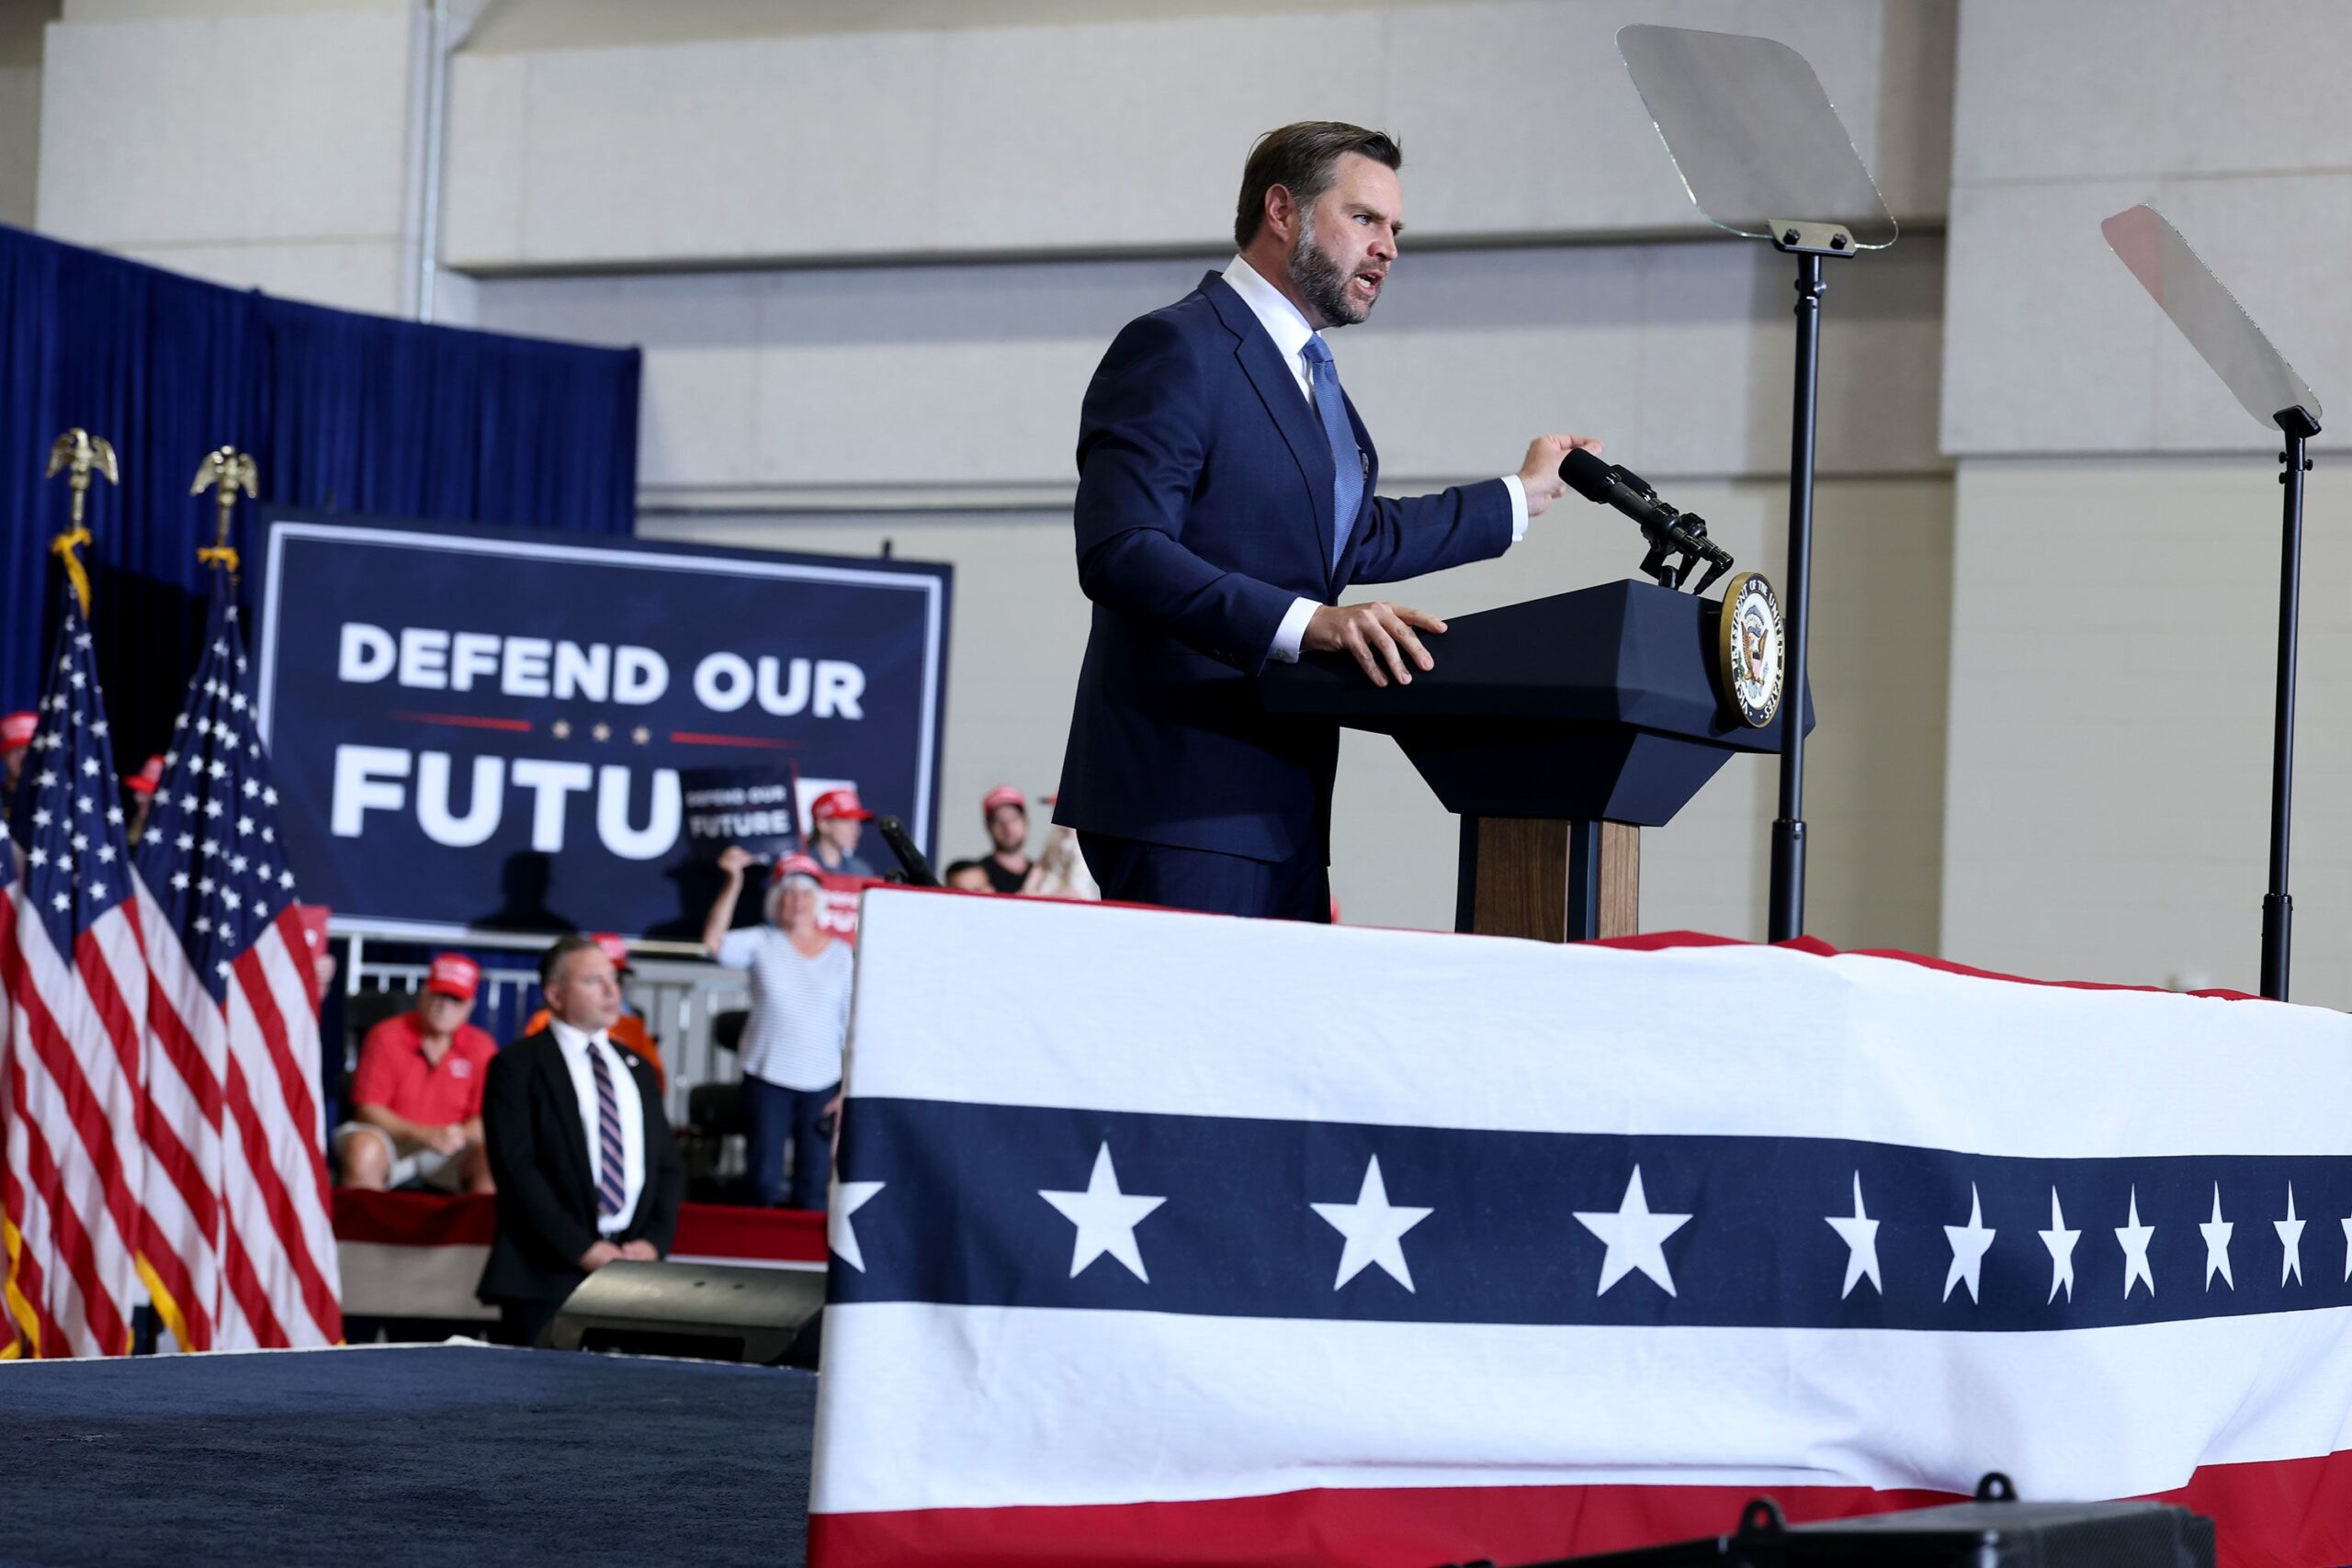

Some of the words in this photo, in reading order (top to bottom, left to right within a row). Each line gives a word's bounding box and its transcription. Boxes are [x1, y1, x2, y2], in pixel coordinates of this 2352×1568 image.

[1749, 580, 1757, 591] OF
[1758, 580, 1769, 596] THE
[339, 622, 670, 705] DEFEND
[694, 651, 867, 720] OUR
[689, 808, 791, 839] FUTURE
